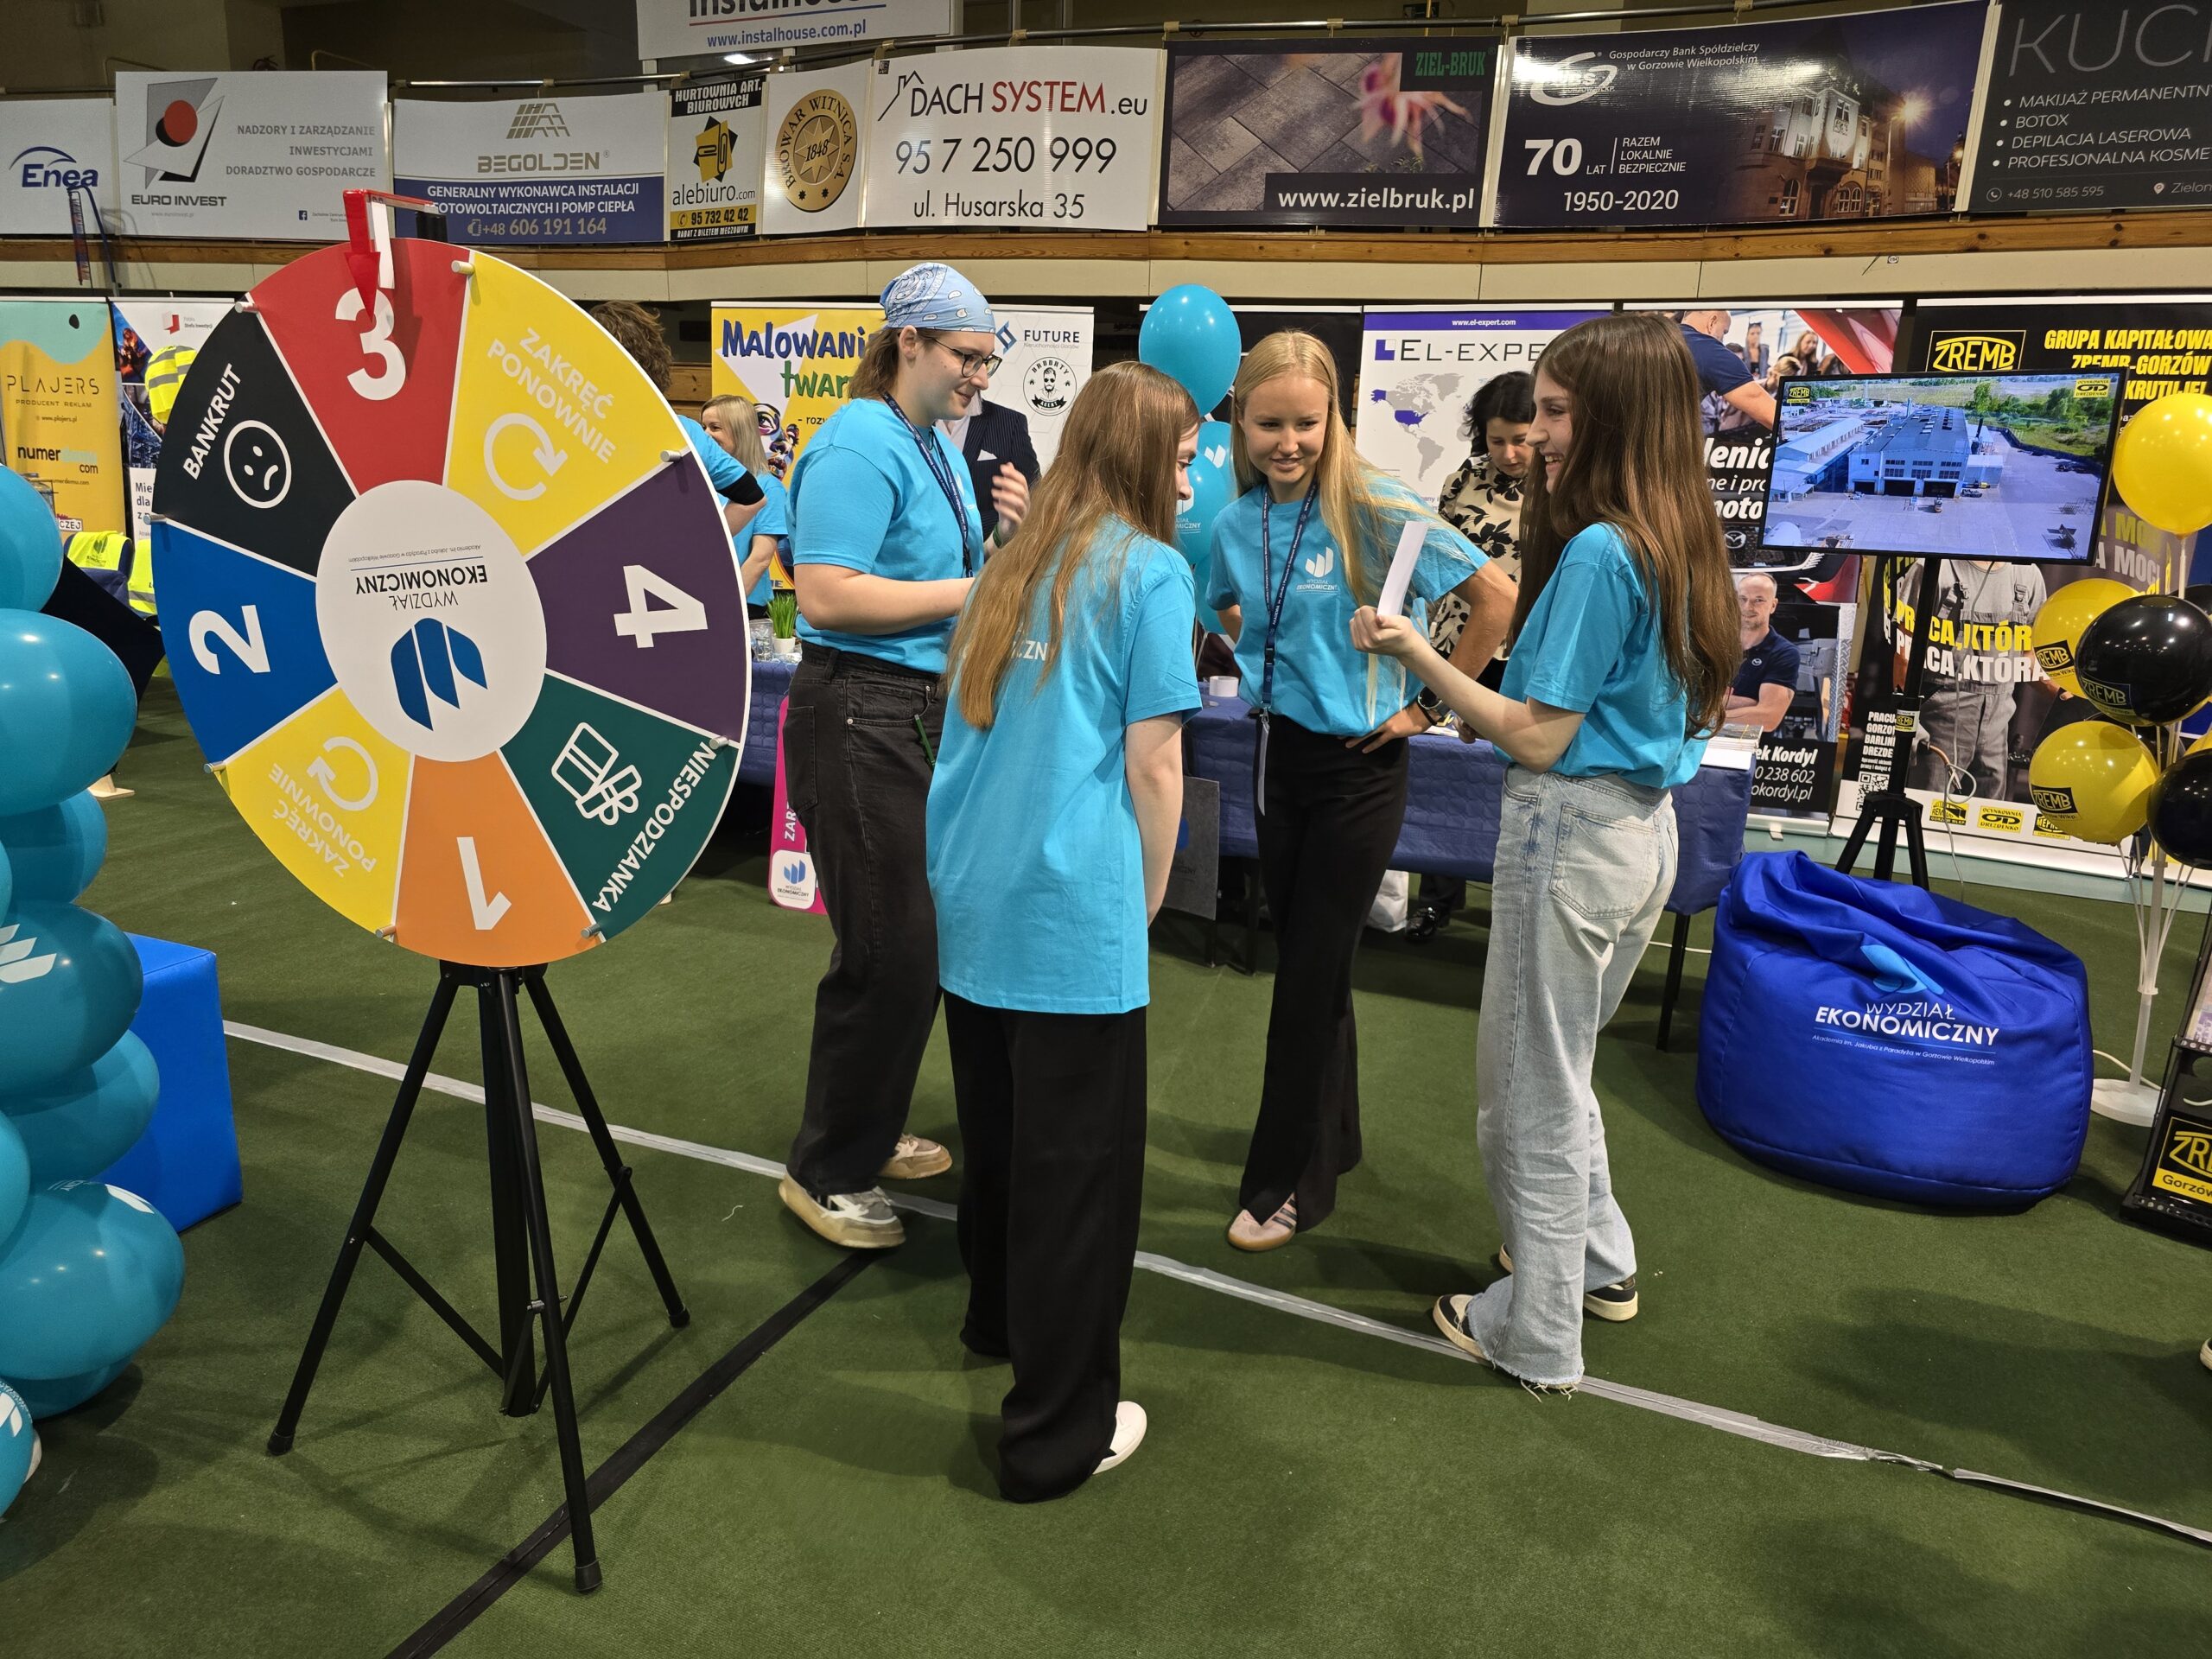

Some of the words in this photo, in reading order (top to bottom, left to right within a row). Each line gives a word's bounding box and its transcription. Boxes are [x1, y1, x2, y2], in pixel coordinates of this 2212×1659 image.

[707, 18, 866, 48] www.instalhouse.com.pl
[1609, 49, 1670, 60] Gospodarczy
[1672, 46, 1696, 56] Bank
[1699, 42, 1760, 55] Spółdzielczy
[1414, 52, 1486, 77] ZIEL-BRUK
[1638, 60, 1684, 70] Gorzowie
[1687, 55, 1758, 69] Wielkopolskim
[675, 82, 736, 103] HURTOWNIA
[740, 79, 762, 92] ART.
[910, 82, 984, 117] DACH
[2019, 90, 2088, 108] MAKIJAŻ
[687, 93, 749, 114] BIUROWYCH
[237, 125, 287, 136] NADZORY
[290, 125, 296, 136] I
[298, 125, 375, 137] ZARZĄDZANIE
[2015, 114, 2069, 129] BOTOX
[779, 108, 807, 189] BROWAR
[809, 96, 853, 145] WITNICA
[1622, 137, 1661, 147] RAZEM
[2012, 133, 2094, 149] DEPILACJA
[2098, 128, 2191, 144] LASEROWA
[289, 146, 373, 157] INWESTYCJAMI
[806, 138, 830, 162] 1848
[896, 139, 931, 175] 95
[941, 138, 963, 173] 7
[971, 137, 1035, 173] 250
[1049, 137, 1117, 174] 999
[1524, 138, 1582, 176] 70
[1586, 164, 1606, 175] LAT
[1621, 149, 1673, 160] LOKALNIE
[2008, 151, 2145, 168] PROFESJONALNA
[2149, 147, 2212, 162] KOSME
[226, 165, 294, 176] DORADZTWO
[296, 167, 376, 178] GOSPODARCZE
[478, 152, 600, 173] BEGOLDEN
[1618, 162, 1687, 174] BEZPIECZNIE
[22, 163, 99, 188] Enea
[131, 194, 171, 206] EURO
[175, 195, 227, 207] INVEST
[427, 186, 496, 198] GENERALNY
[499, 185, 576, 198] WYKONAWCA
[578, 182, 639, 196] INSTALACJI
[672, 183, 755, 206] alebiuro.com
[1278, 188, 1474, 213] www.zielbruk.pl
[1564, 189, 1679, 211] 1950-2020
[2007, 189, 2029, 200] +48
[2031, 188, 2053, 199] 510
[2056, 188, 2078, 199] 585
[2082, 186, 2105, 197] 595
[556, 202, 559, 213] I
[562, 201, 598, 213] POMP
[601, 200, 635, 213] CIEPŁA
[913, 189, 935, 217] ul.
[944, 189, 1044, 217] Husarska
[1053, 194, 1085, 219] 35
[482, 223, 505, 236] +48
[510, 219, 538, 236] 606
[543, 218, 572, 236] 191
[577, 217, 607, 234] 164
[691, 213, 702, 226] 95
[705, 210, 721, 225] 732
[723, 209, 734, 223] 42
[737, 207, 748, 221] 42
[697, 227, 719, 238] BILETEM
[720, 226, 748, 236] MECZOWYM
[335, 287, 406, 401] 3
[1024, 330, 1080, 343] FUTURE
[2044, 329, 2099, 350] GRUPA
[1400, 339, 1547, 361] EL-EXPE
[1933, 336, 2017, 372] ZREMB
[519, 327, 614, 420] ZAKRĘĆ
[7, 375, 100, 395] PLAJERS
[2125, 380, 2209, 399] KRUTUJE!
[486, 339, 617, 464] PONOWNIE
[182, 363, 243, 480] BANKRUT
[79, 464, 99, 474] com
[135, 482, 152, 493] Mie
[137, 495, 150, 506] dla
[356, 564, 488, 594] EKONOMICZNY
[388, 590, 459, 611] WYDZIAŁ
[614, 564, 709, 648] 4
[188, 605, 271, 675] 2
[1963, 620, 2032, 652] KTÓR
[1868, 711, 1896, 724] PRACU
[1771, 746, 1818, 768] Kordyl
[1862, 745, 1894, 759] DREZDE
[1764, 766, 1789, 782] 238
[1791, 769, 1815, 784] 602
[1751, 782, 1813, 803] okordyl.pl
[268, 762, 378, 872] PONOWNIE
[1982, 807, 2022, 817] OCYNKOWNIA
[591, 741, 718, 912] NIESPODZIANKA
[272, 798, 350, 878] ZAKRĘĆ
[457, 836, 512, 930] 1
[1866, 1001, 1955, 1020] WYDZIAŁ
[1815, 1006, 1999, 1046] EKONOMICZNY
[1813, 1034, 1843, 1046] Akademia
[1854, 1040, 1878, 1051] Jakuba
[1884, 1046, 1914, 1058] Paradyża
[1923, 1051, 1952, 1061] Gorzowie
[1954, 1055, 1995, 1065] Wielkopolskim
